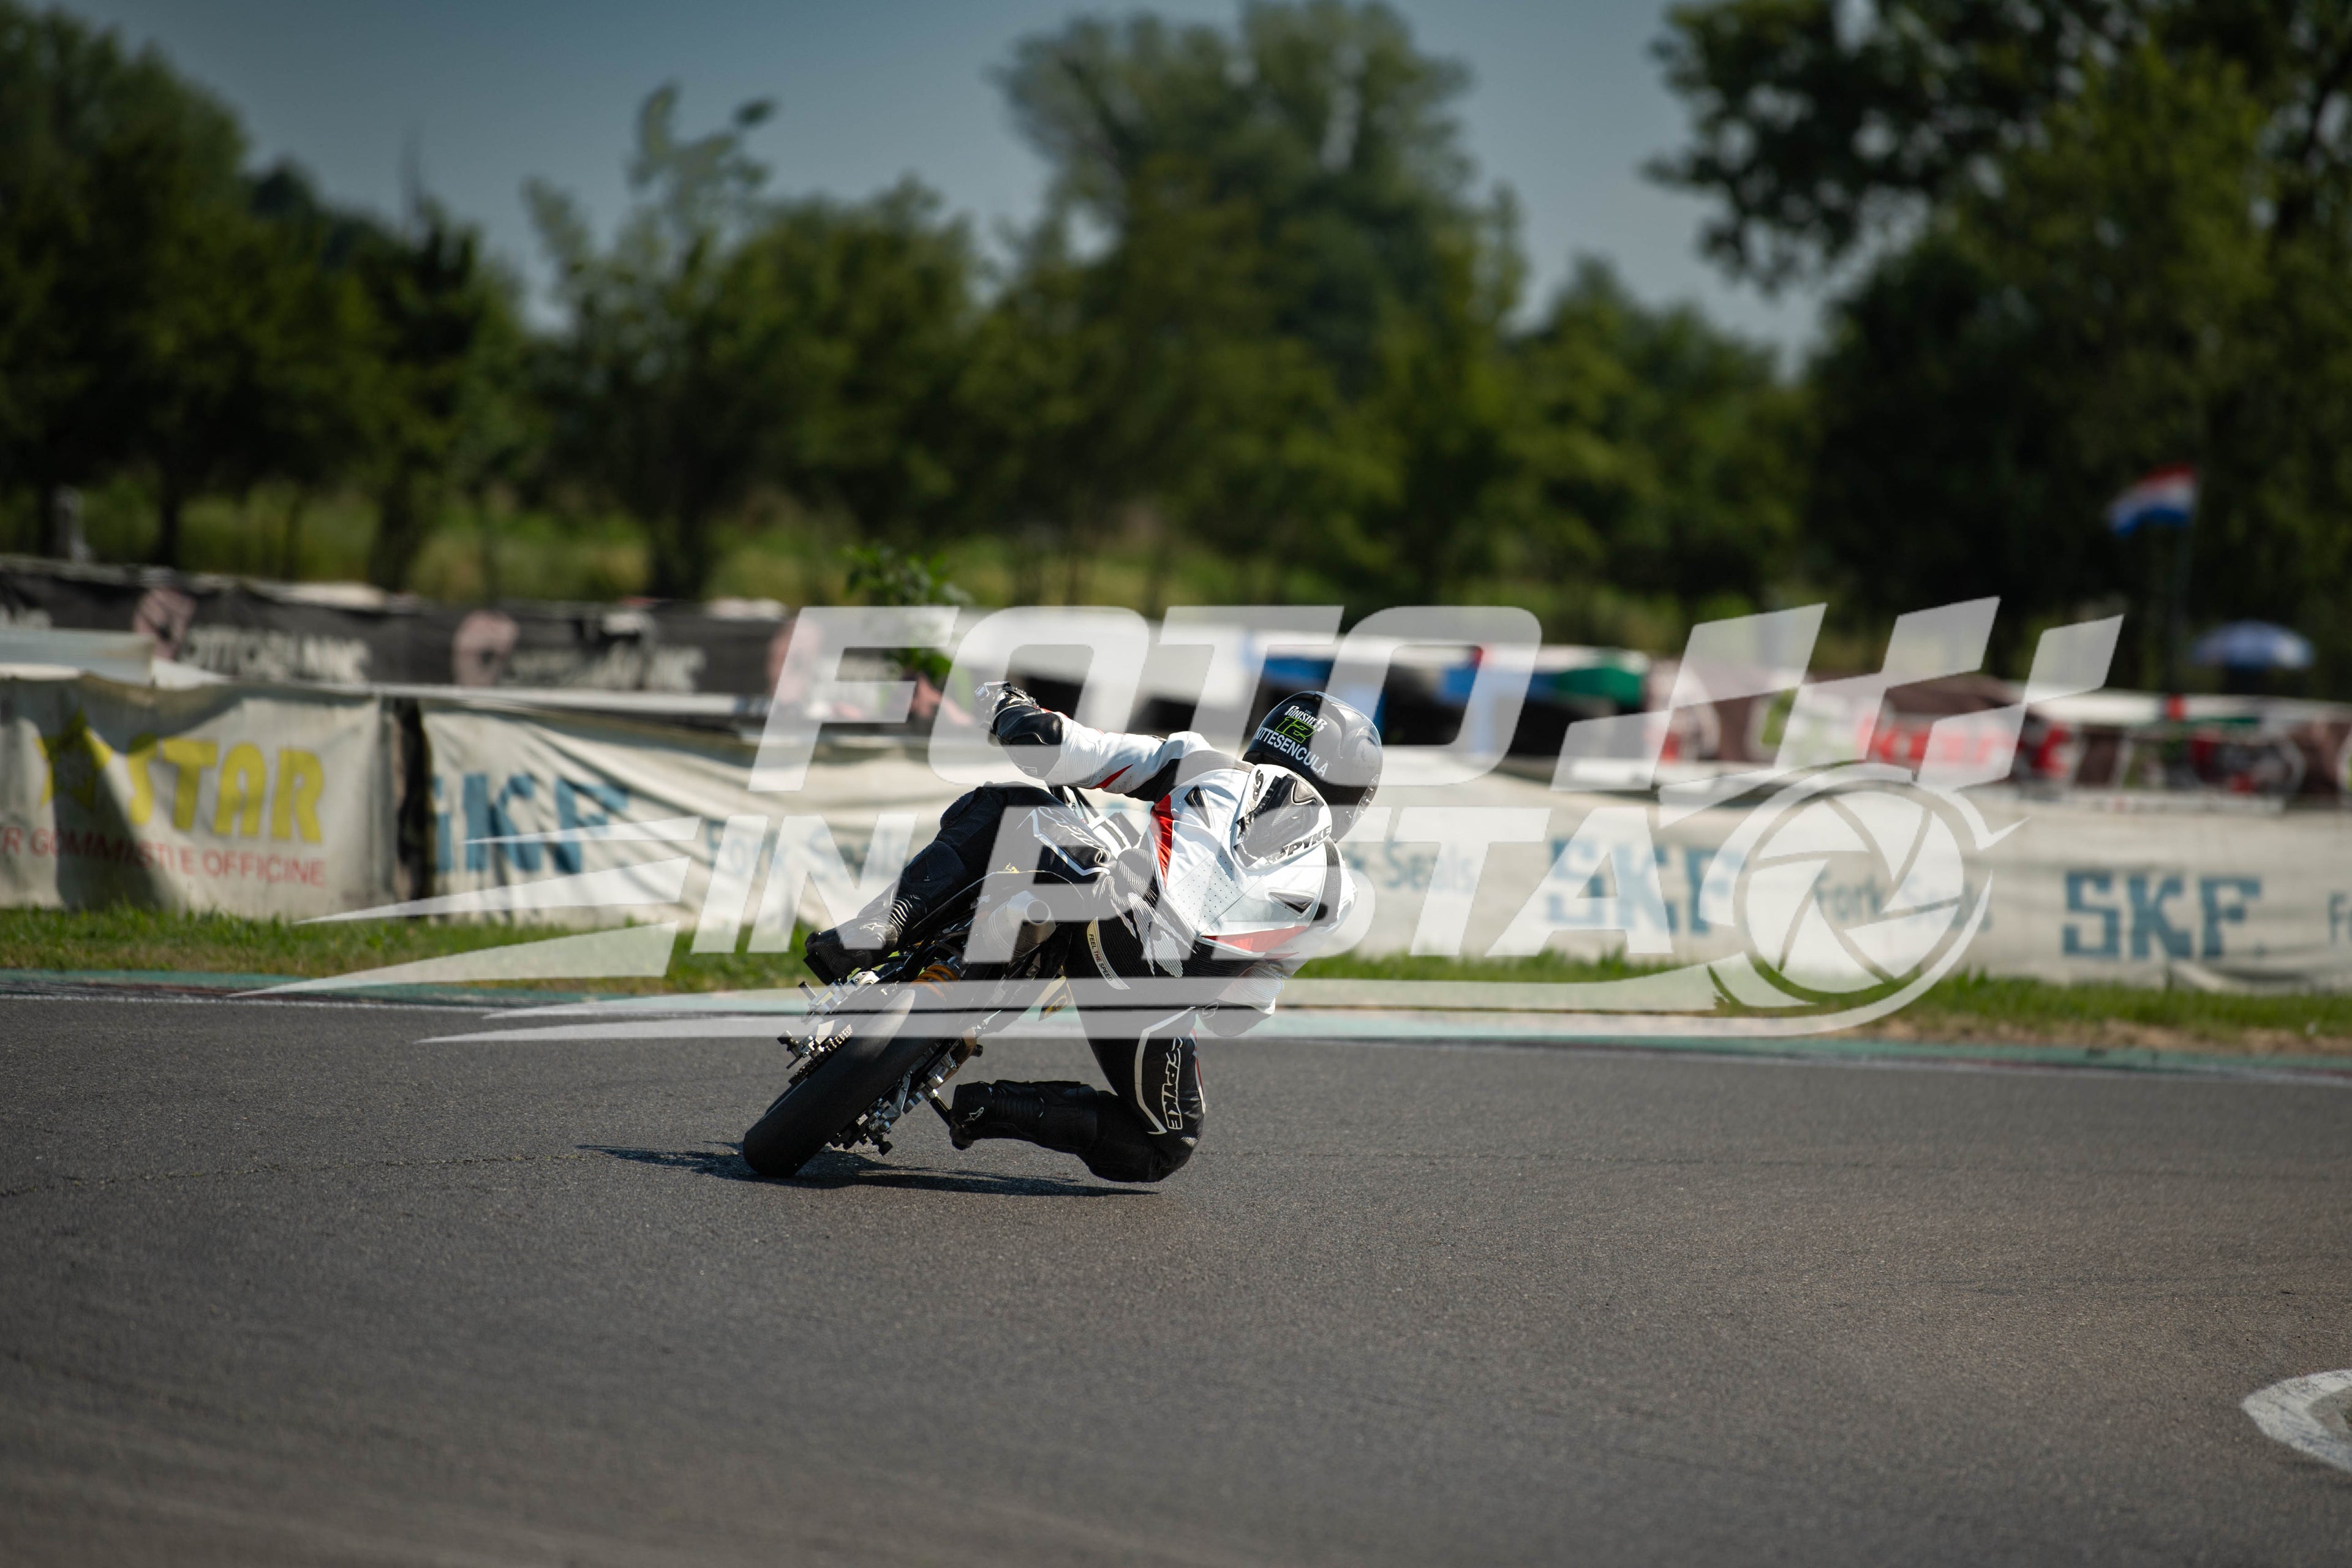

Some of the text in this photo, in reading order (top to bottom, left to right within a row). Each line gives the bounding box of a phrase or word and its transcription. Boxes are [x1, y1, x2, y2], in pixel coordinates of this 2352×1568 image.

[1275, 716, 1316, 744] 12
[1284, 706, 1328, 732] PUNISHER
[202, 850, 326, 888] OFFICINE
[2062, 870, 2263, 960] SKF
[1088, 934, 1097, 949] FEEL
[1161, 1036, 1183, 1130] SPYKE
